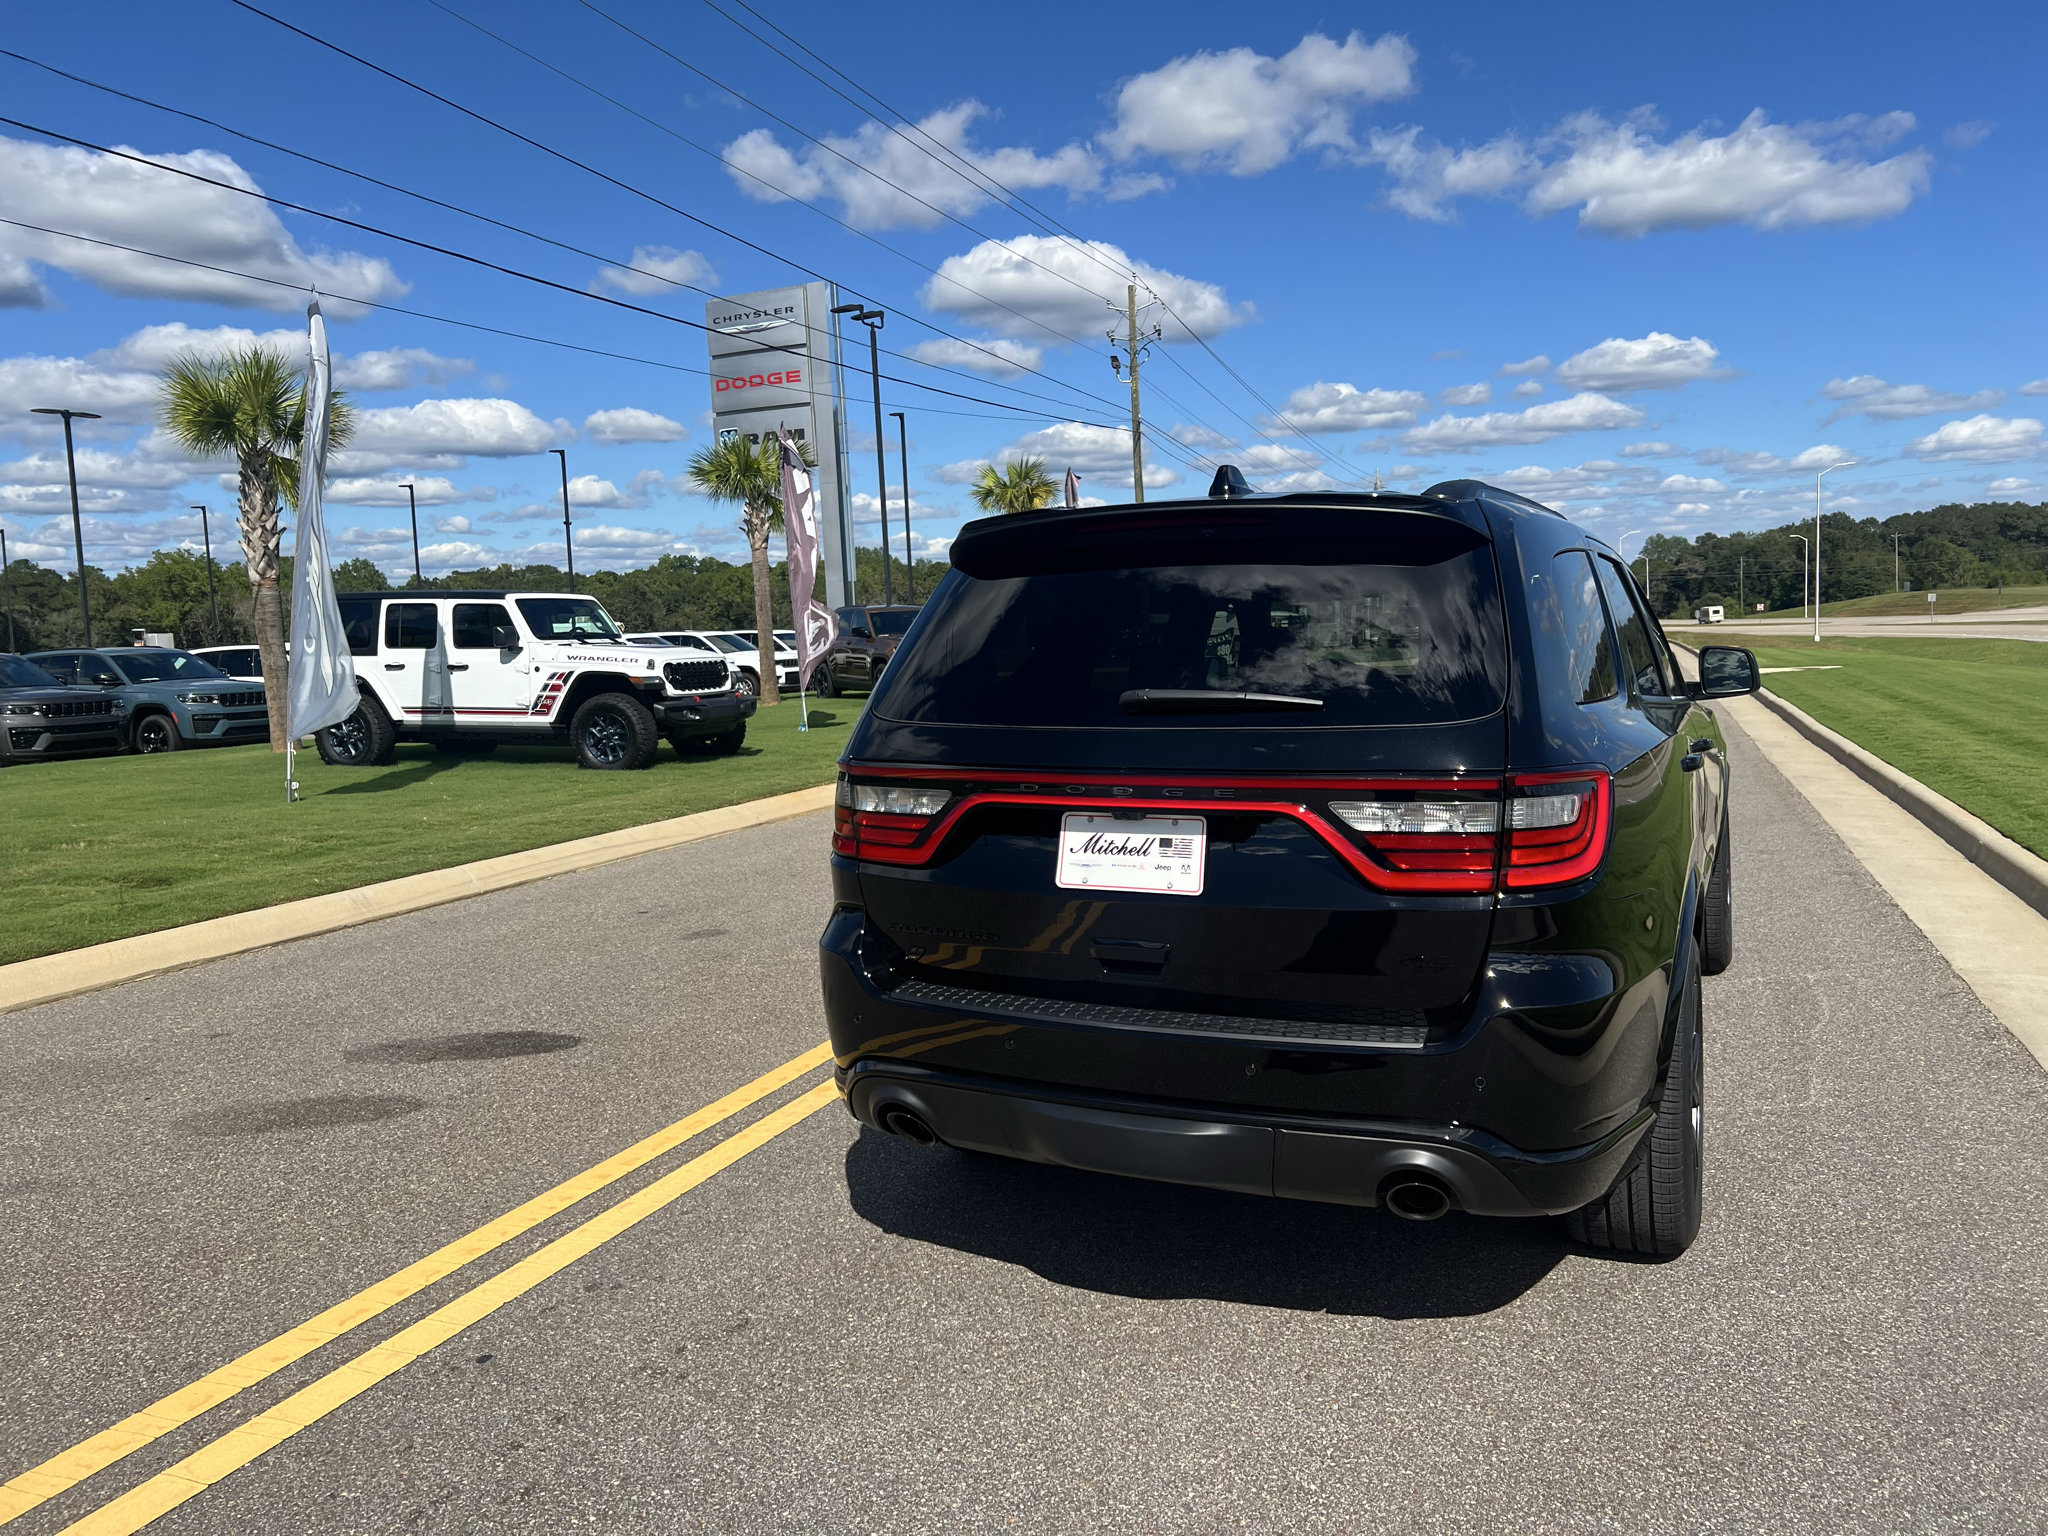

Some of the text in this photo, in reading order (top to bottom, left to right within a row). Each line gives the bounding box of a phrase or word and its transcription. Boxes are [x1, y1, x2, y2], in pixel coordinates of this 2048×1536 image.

[713, 306, 794, 324] CHRYSLER
[716, 370, 801, 392] DODGE
[567, 654, 639, 664] WRANGLER
[1019, 783, 1235, 798] DODGE
[1070, 832, 1157, 857] Mitchell
[1155, 863, 1172, 871] Jeep
